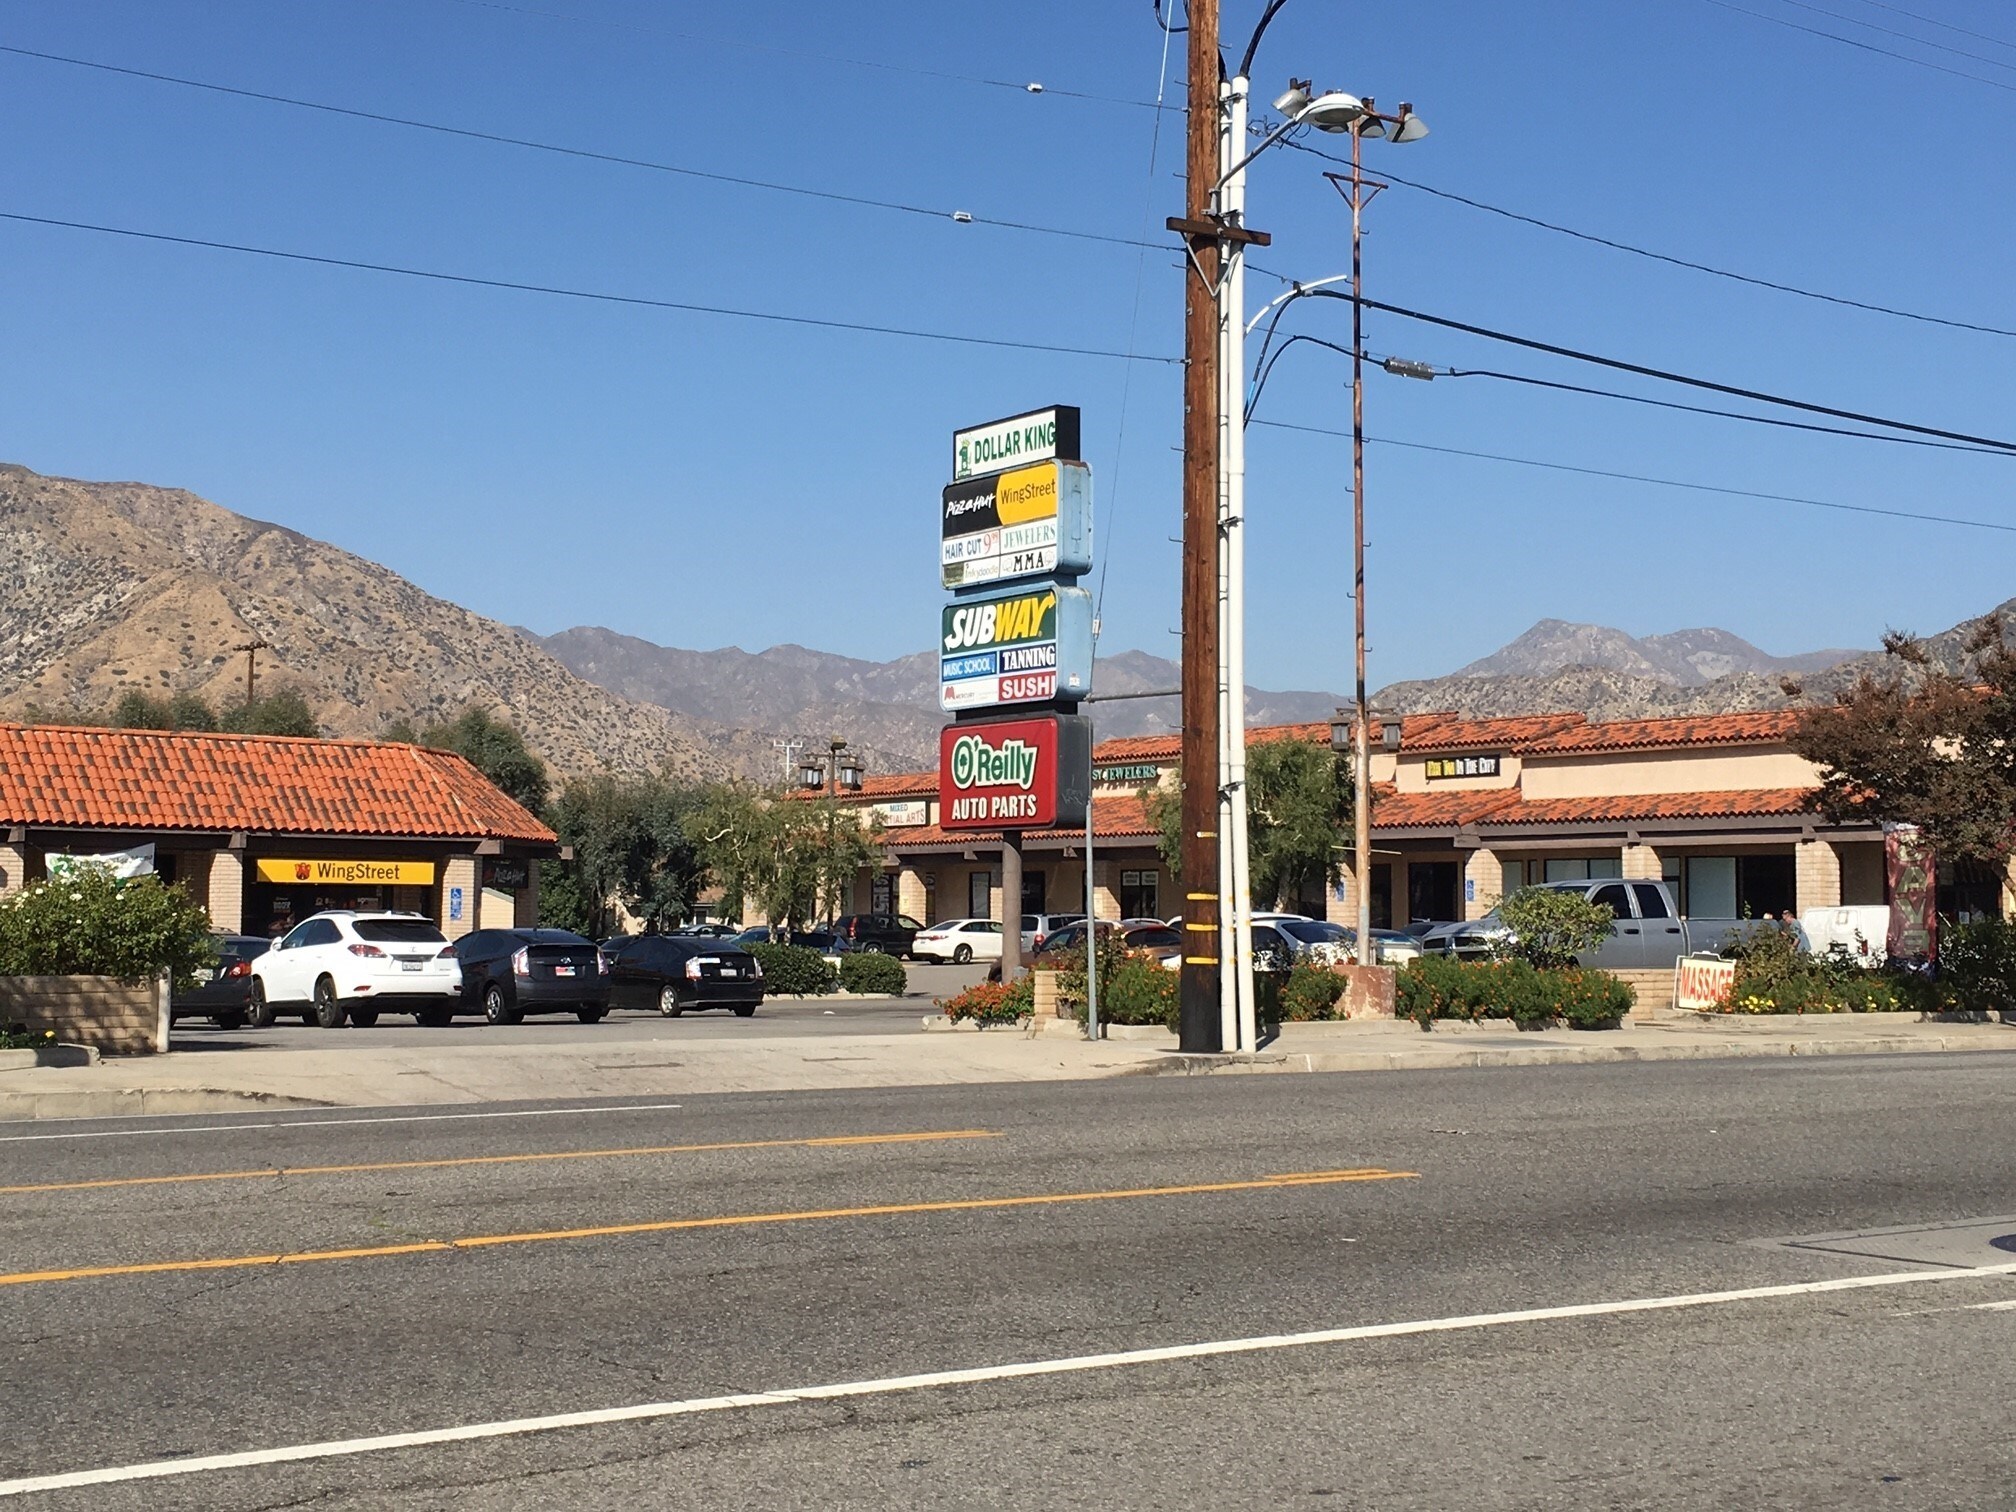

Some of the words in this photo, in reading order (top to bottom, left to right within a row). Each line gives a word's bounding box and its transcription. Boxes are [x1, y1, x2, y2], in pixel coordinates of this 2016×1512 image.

[975, 431, 1021, 465] DOLLAR
[1025, 421, 1056, 453] KING
[1001, 478, 1056, 505] WingStreet
[945, 542, 964, 560] HAIR
[966, 538, 982, 556] CUT
[1003, 525, 1056, 550] JEWELERS
[1013, 551, 1045, 573] MMA
[944, 591, 1056, 652] SUBWAY
[943, 663, 963, 677] MUSIC
[964, 658, 991, 674] SCHOOL
[1002, 645, 1056, 671] TANNING
[1001, 675, 1057, 699] SUSHI
[953, 736, 1036, 789] O'Reilly
[1103, 764, 1157, 781] JEWELERS
[889, 803, 909, 812] MIXED
[906, 808, 925, 825] ARTS
[951, 797, 988, 821] AUTO
[991, 793, 1038, 819] PARTS
[317, 863, 401, 881] WingStreet
